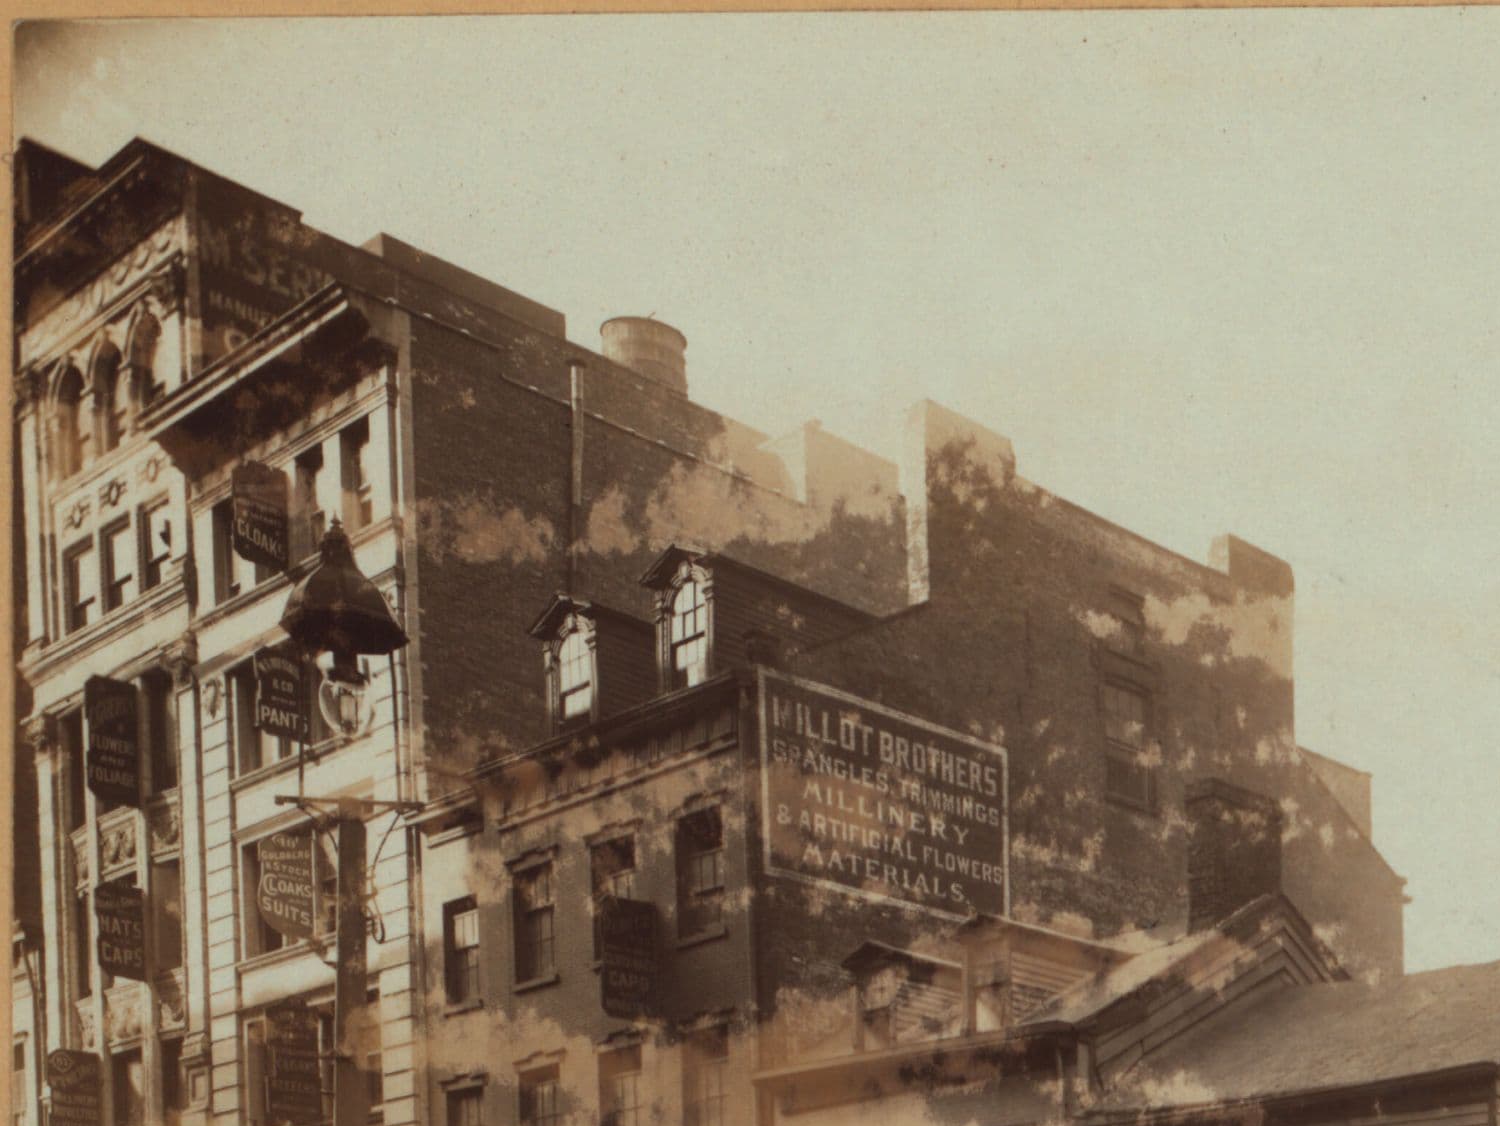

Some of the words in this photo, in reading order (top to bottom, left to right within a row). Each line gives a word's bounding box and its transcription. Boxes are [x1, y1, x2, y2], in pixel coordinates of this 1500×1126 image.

[879, 729, 998, 797] BROTHERS
[803, 777, 969, 846] MILLINERY
[899, 775, 1000, 827] TRIMMINGS
[777, 803, 792, 825] &
[799, 808, 918, 863] ARTIFICIAL
[923, 845, 1003, 886] FLOWERS
[263, 873, 313, 899] CLOAKS
[100, 913, 143, 940] HATS
[101, 940, 144, 969] CAPS
